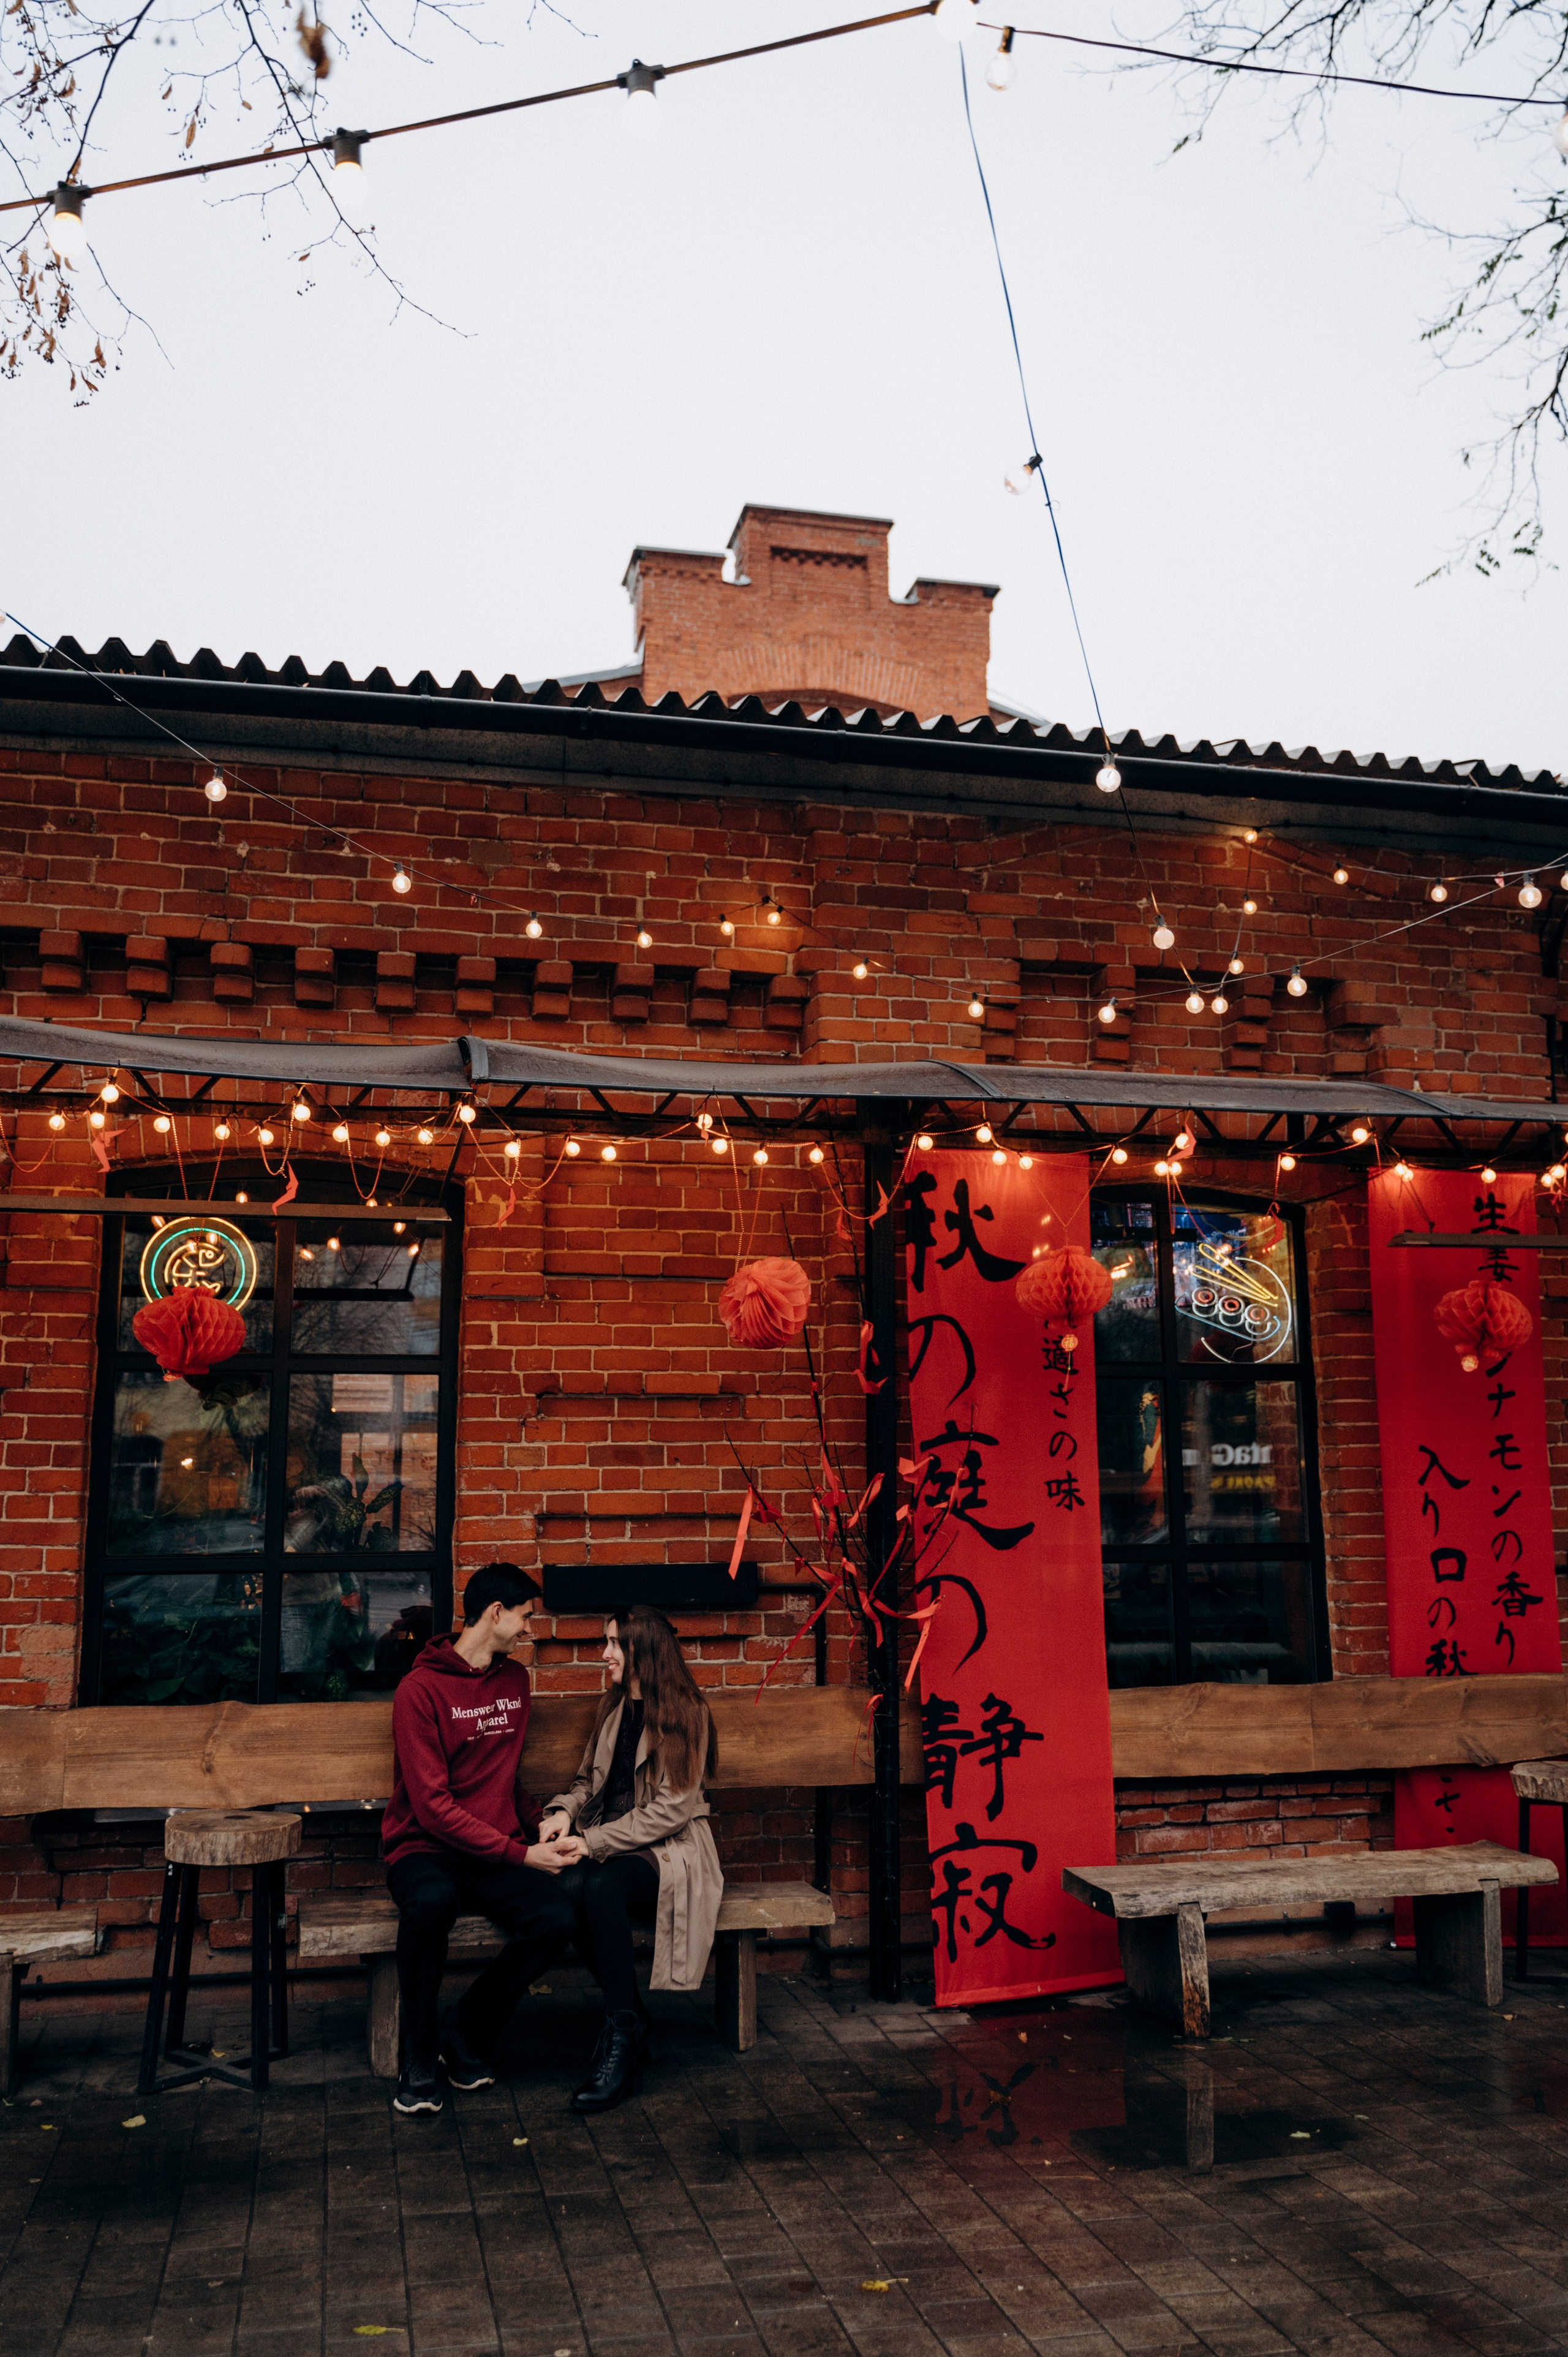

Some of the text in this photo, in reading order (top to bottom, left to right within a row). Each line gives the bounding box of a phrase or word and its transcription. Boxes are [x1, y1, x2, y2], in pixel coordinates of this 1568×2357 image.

[1041, 1318, 1085, 1511] 適さの味
[496, 1697, 521, 1711] Wknd
[476, 1713, 508, 1732] Apparel
